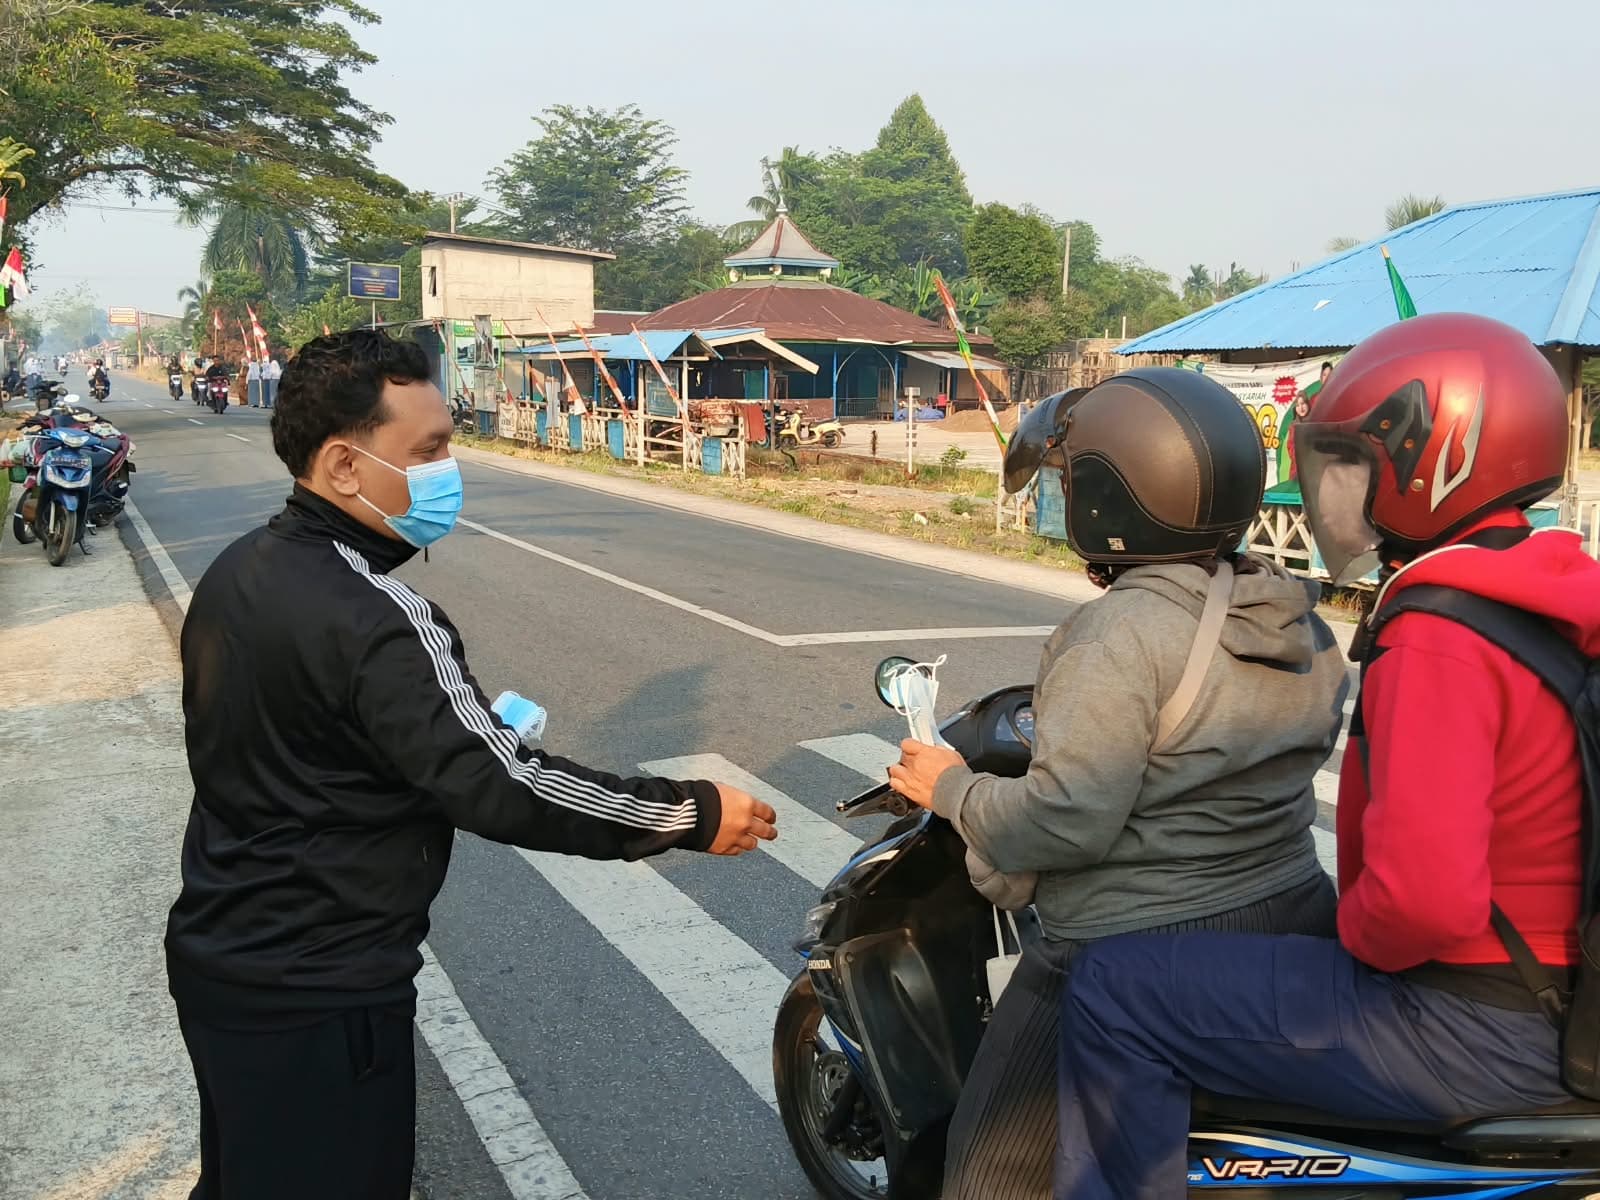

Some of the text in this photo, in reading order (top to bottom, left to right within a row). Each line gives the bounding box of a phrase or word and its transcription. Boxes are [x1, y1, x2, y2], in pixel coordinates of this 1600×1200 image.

[1239, 392, 1267, 400] SYARIAH
[808, 959, 832, 969] HONDA
[1201, 1157, 1350, 1179] VARIO
